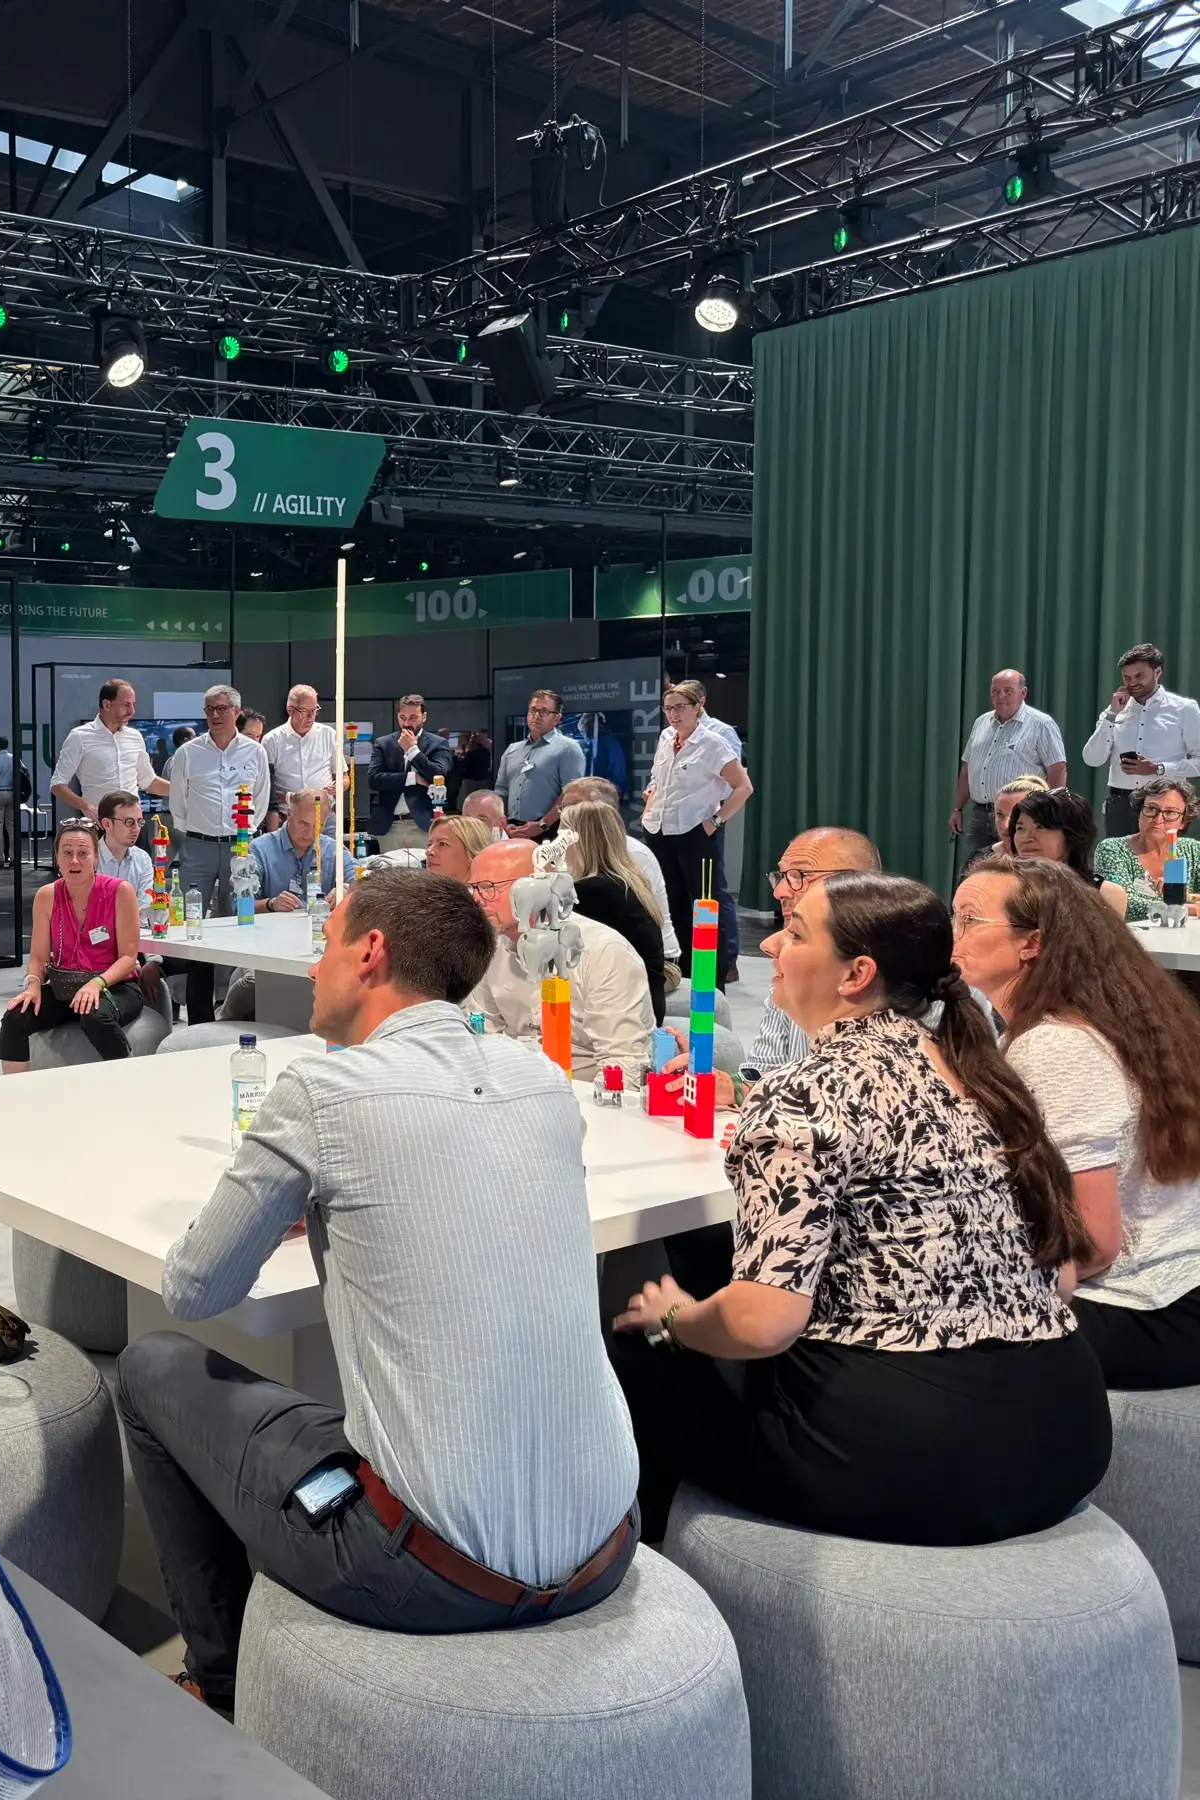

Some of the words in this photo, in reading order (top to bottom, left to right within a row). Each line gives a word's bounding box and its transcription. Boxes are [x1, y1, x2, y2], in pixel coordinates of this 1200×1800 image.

[196, 432, 237, 511] 3
[272, 494, 347, 517] AGILITY
[47, 606, 66, 617] THE
[69, 606, 108, 618] FUTURE
